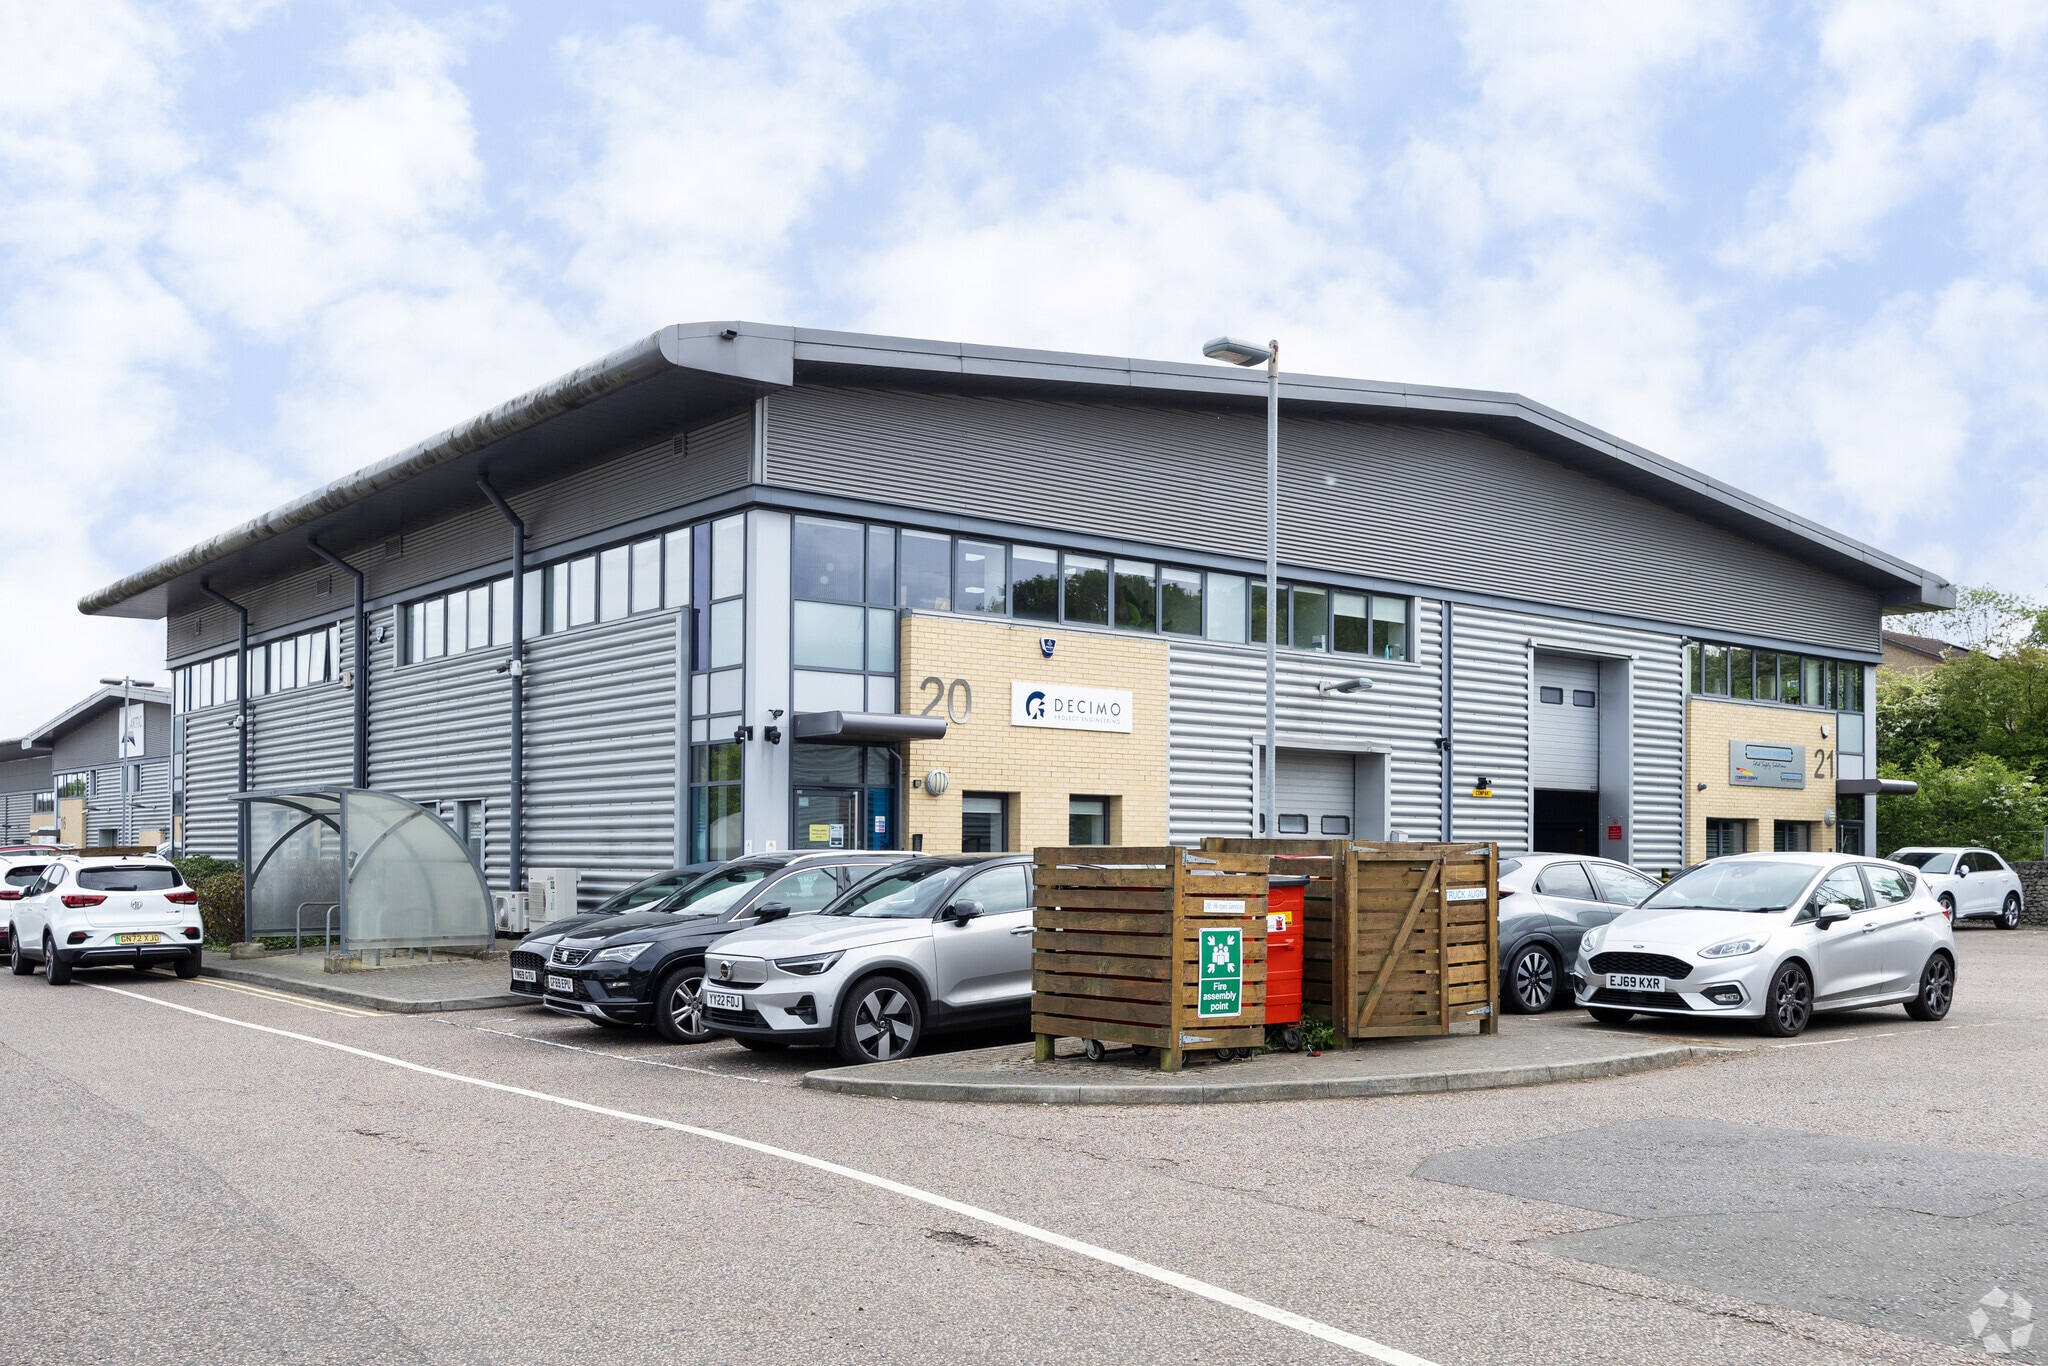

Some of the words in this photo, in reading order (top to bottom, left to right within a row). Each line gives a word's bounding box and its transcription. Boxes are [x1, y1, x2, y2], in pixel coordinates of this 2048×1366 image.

[920, 677, 971, 724] 20
[1054, 698, 1121, 716] DECIMO
[1054, 714, 1079, 722] PROJECT
[1081, 716, 1121, 725] ENGINEERING
[1814, 749, 1833, 779] 21
[120, 934, 142, 943] GN72
[144, 934, 160, 942] XJD
[1213, 982, 1227, 991] Fire
[1610, 976, 1636, 988] EJ69
[1639, 977, 1660, 989] KXR
[709, 993, 725, 1006] YY22
[726, 995, 740, 1008] FDJ
[1203, 991, 1237, 1001] assembly
[1210, 1001, 1229, 1012] point
